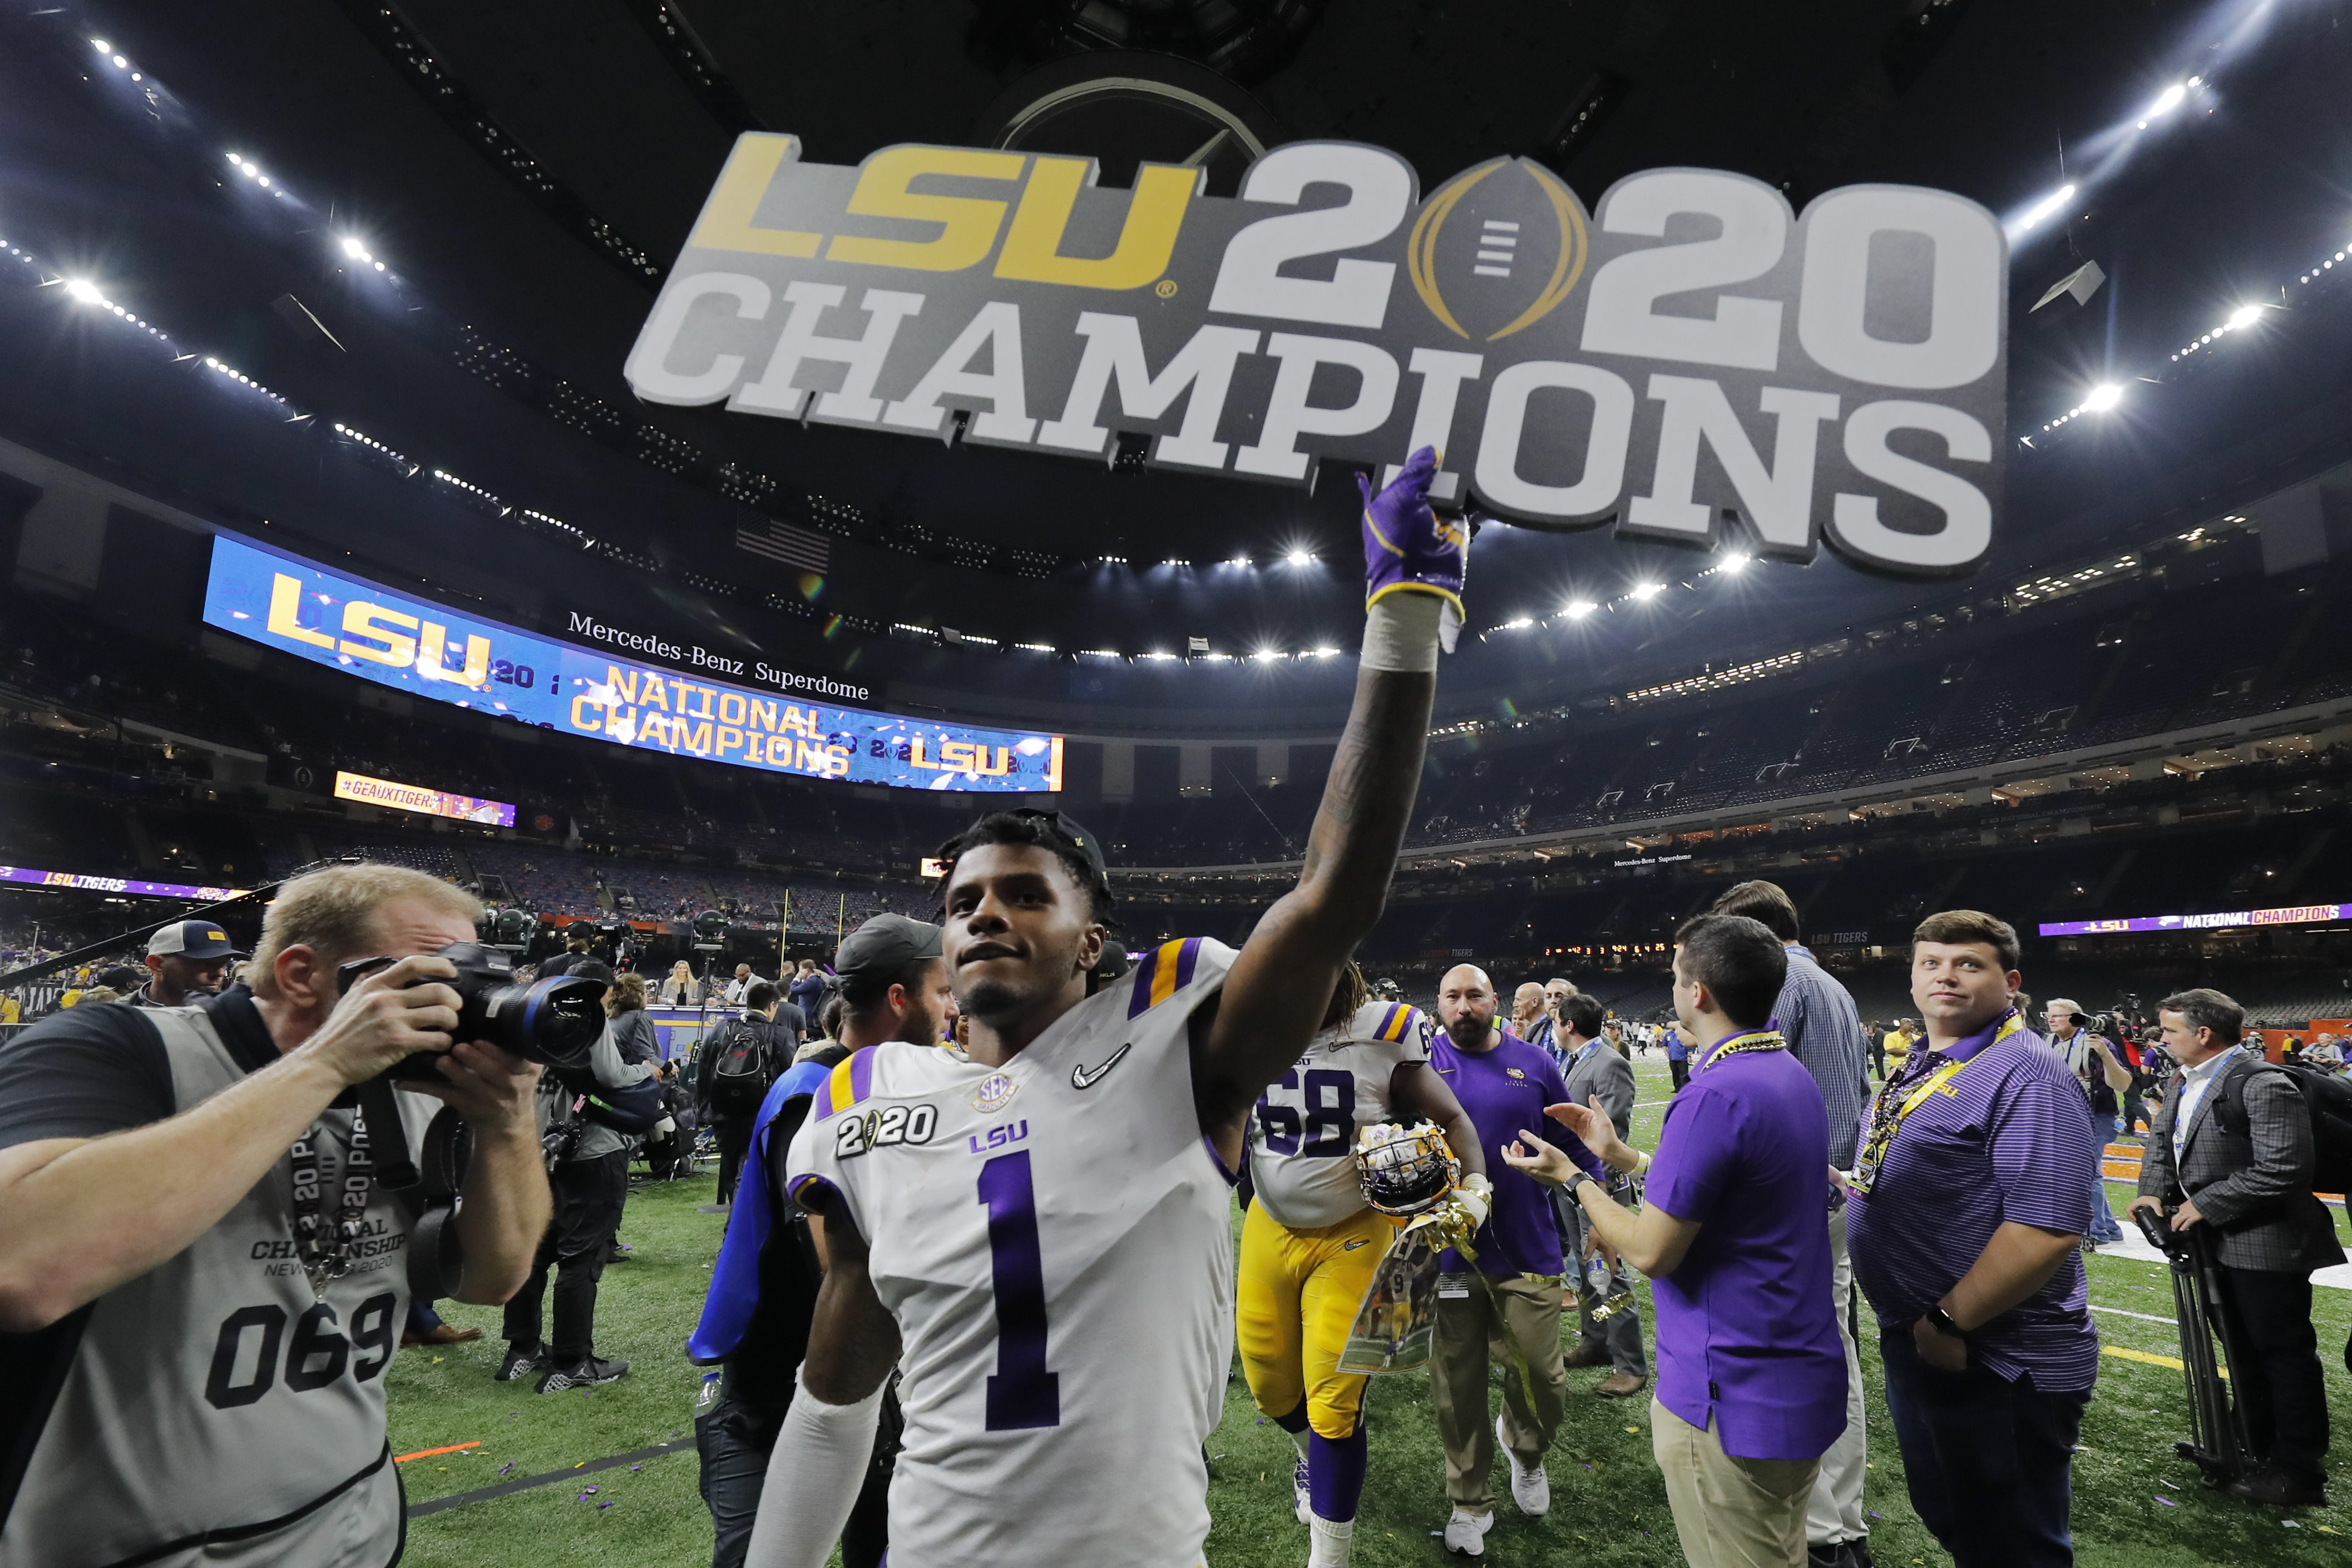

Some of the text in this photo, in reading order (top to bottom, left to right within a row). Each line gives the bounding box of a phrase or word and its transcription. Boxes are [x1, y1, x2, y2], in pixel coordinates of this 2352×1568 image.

[690, 136, 1199, 290] LSU
[631, 271, 1993, 568] CHAMPIONS
[267, 572, 491, 687] LSU
[567, 611, 869, 701] Mercedes-Benz Superdome
[607, 665, 827, 741] NATIONAL
[570, 694, 850, 776] CHAMPIONS
[910, 736, 1010, 776] LSU
[1614, 853, 1692, 867] Mercedes-Benz Superdome
[43, 872, 127, 892] LSU TIGERS
[2089, 919, 2129, 933] LSU
[2182, 905, 2340, 928] NATIONAL CHAMPIONS
[1451, 948, 1473, 957] TIGERS
[1811, 931, 1868, 944] LSU TIGERS
[980, 1074, 1010, 1102] SEC
[1935, 1082, 1959, 1097] SU
[1256, 1067, 1356, 1158] 68
[969, 1119, 1028, 1155] LSU
[977, 1149, 1060, 1432] 1
[205, 1292, 397, 1411] 069
